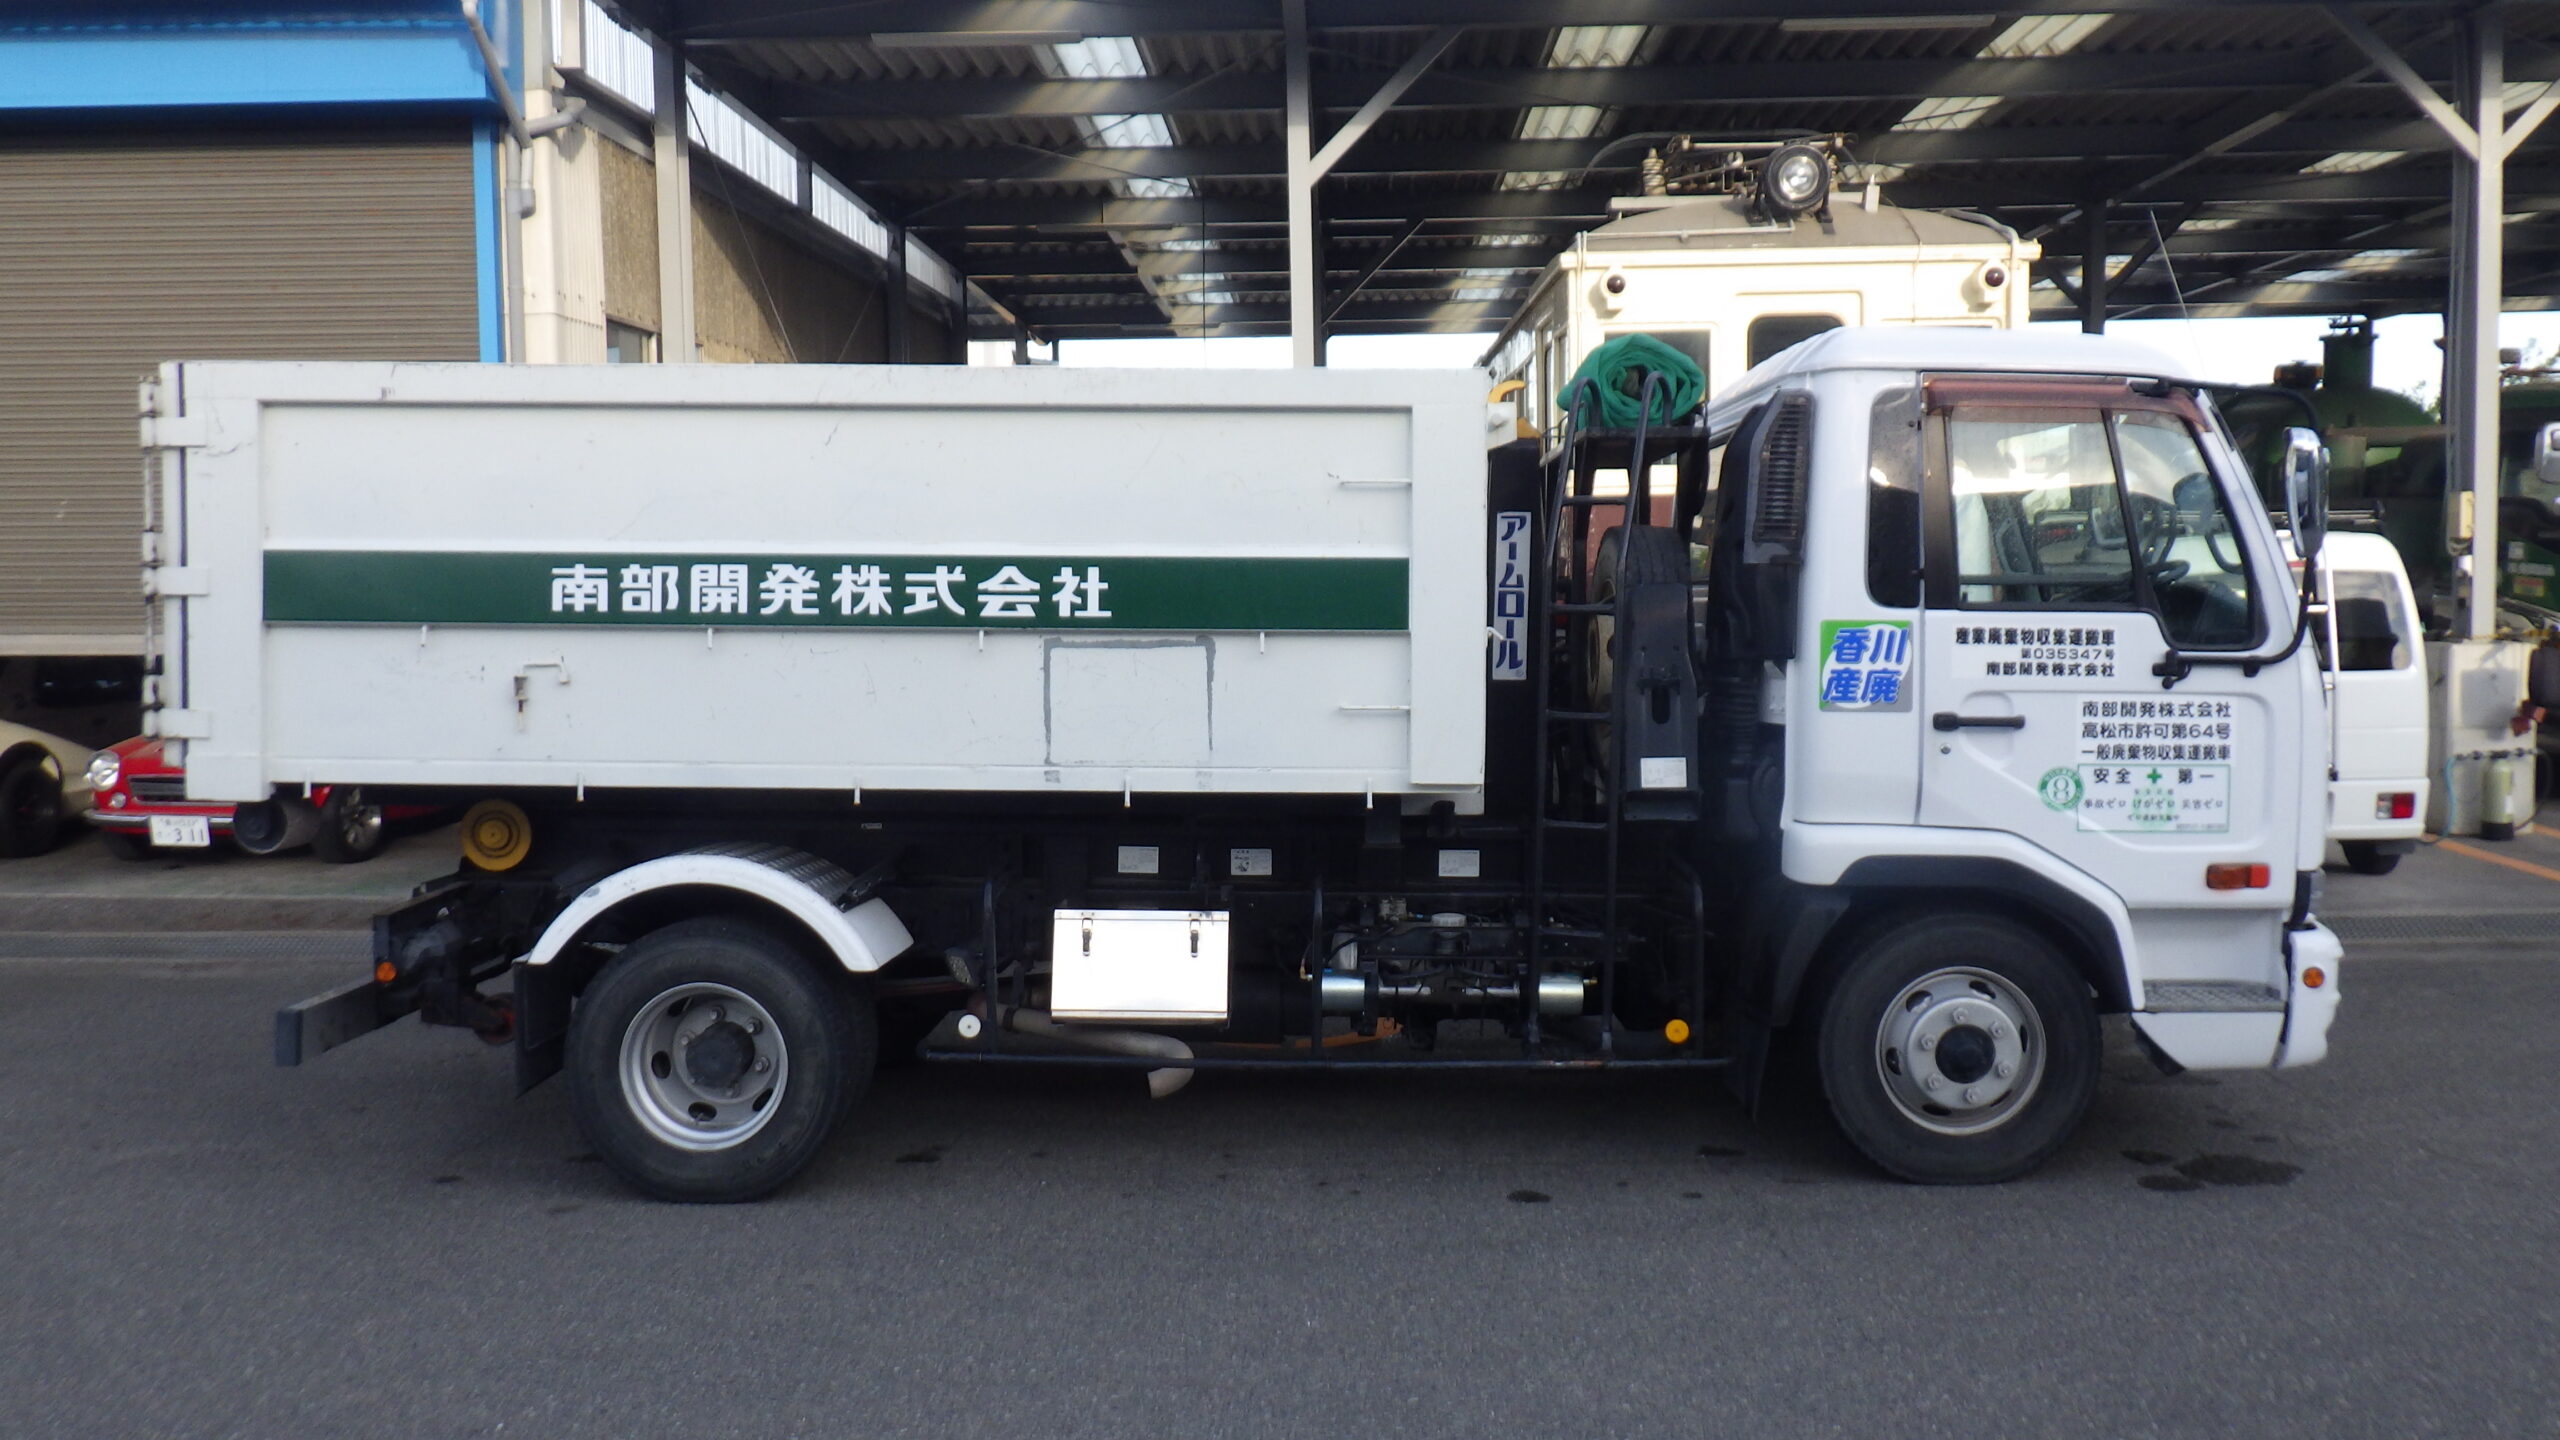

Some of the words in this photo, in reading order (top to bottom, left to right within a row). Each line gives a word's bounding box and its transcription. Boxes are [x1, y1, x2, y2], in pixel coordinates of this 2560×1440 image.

[551, 563, 1112, 618] 南部開発株式会社
[1496, 515, 1527, 669] アームロール
[1955, 627, 2116, 646] 産業廃棄物収集運搬車
[1831, 627, 1909, 665] 香川
[2021, 648, 2116, 660] 第035347号
[1986, 661, 2116, 677] 南部開発株式会社
[1822, 667, 1903, 704] 産廃
[2082, 701, 2232, 718] 南部開発株式会社
[2081, 722, 2232, 739] 高松市許可第64号
[2081, 743, 2232, 761] 一般廃棄物収集運搬車
[2093, 768, 2131, 785] 安全
[2178, 768, 2215, 785] 第一
